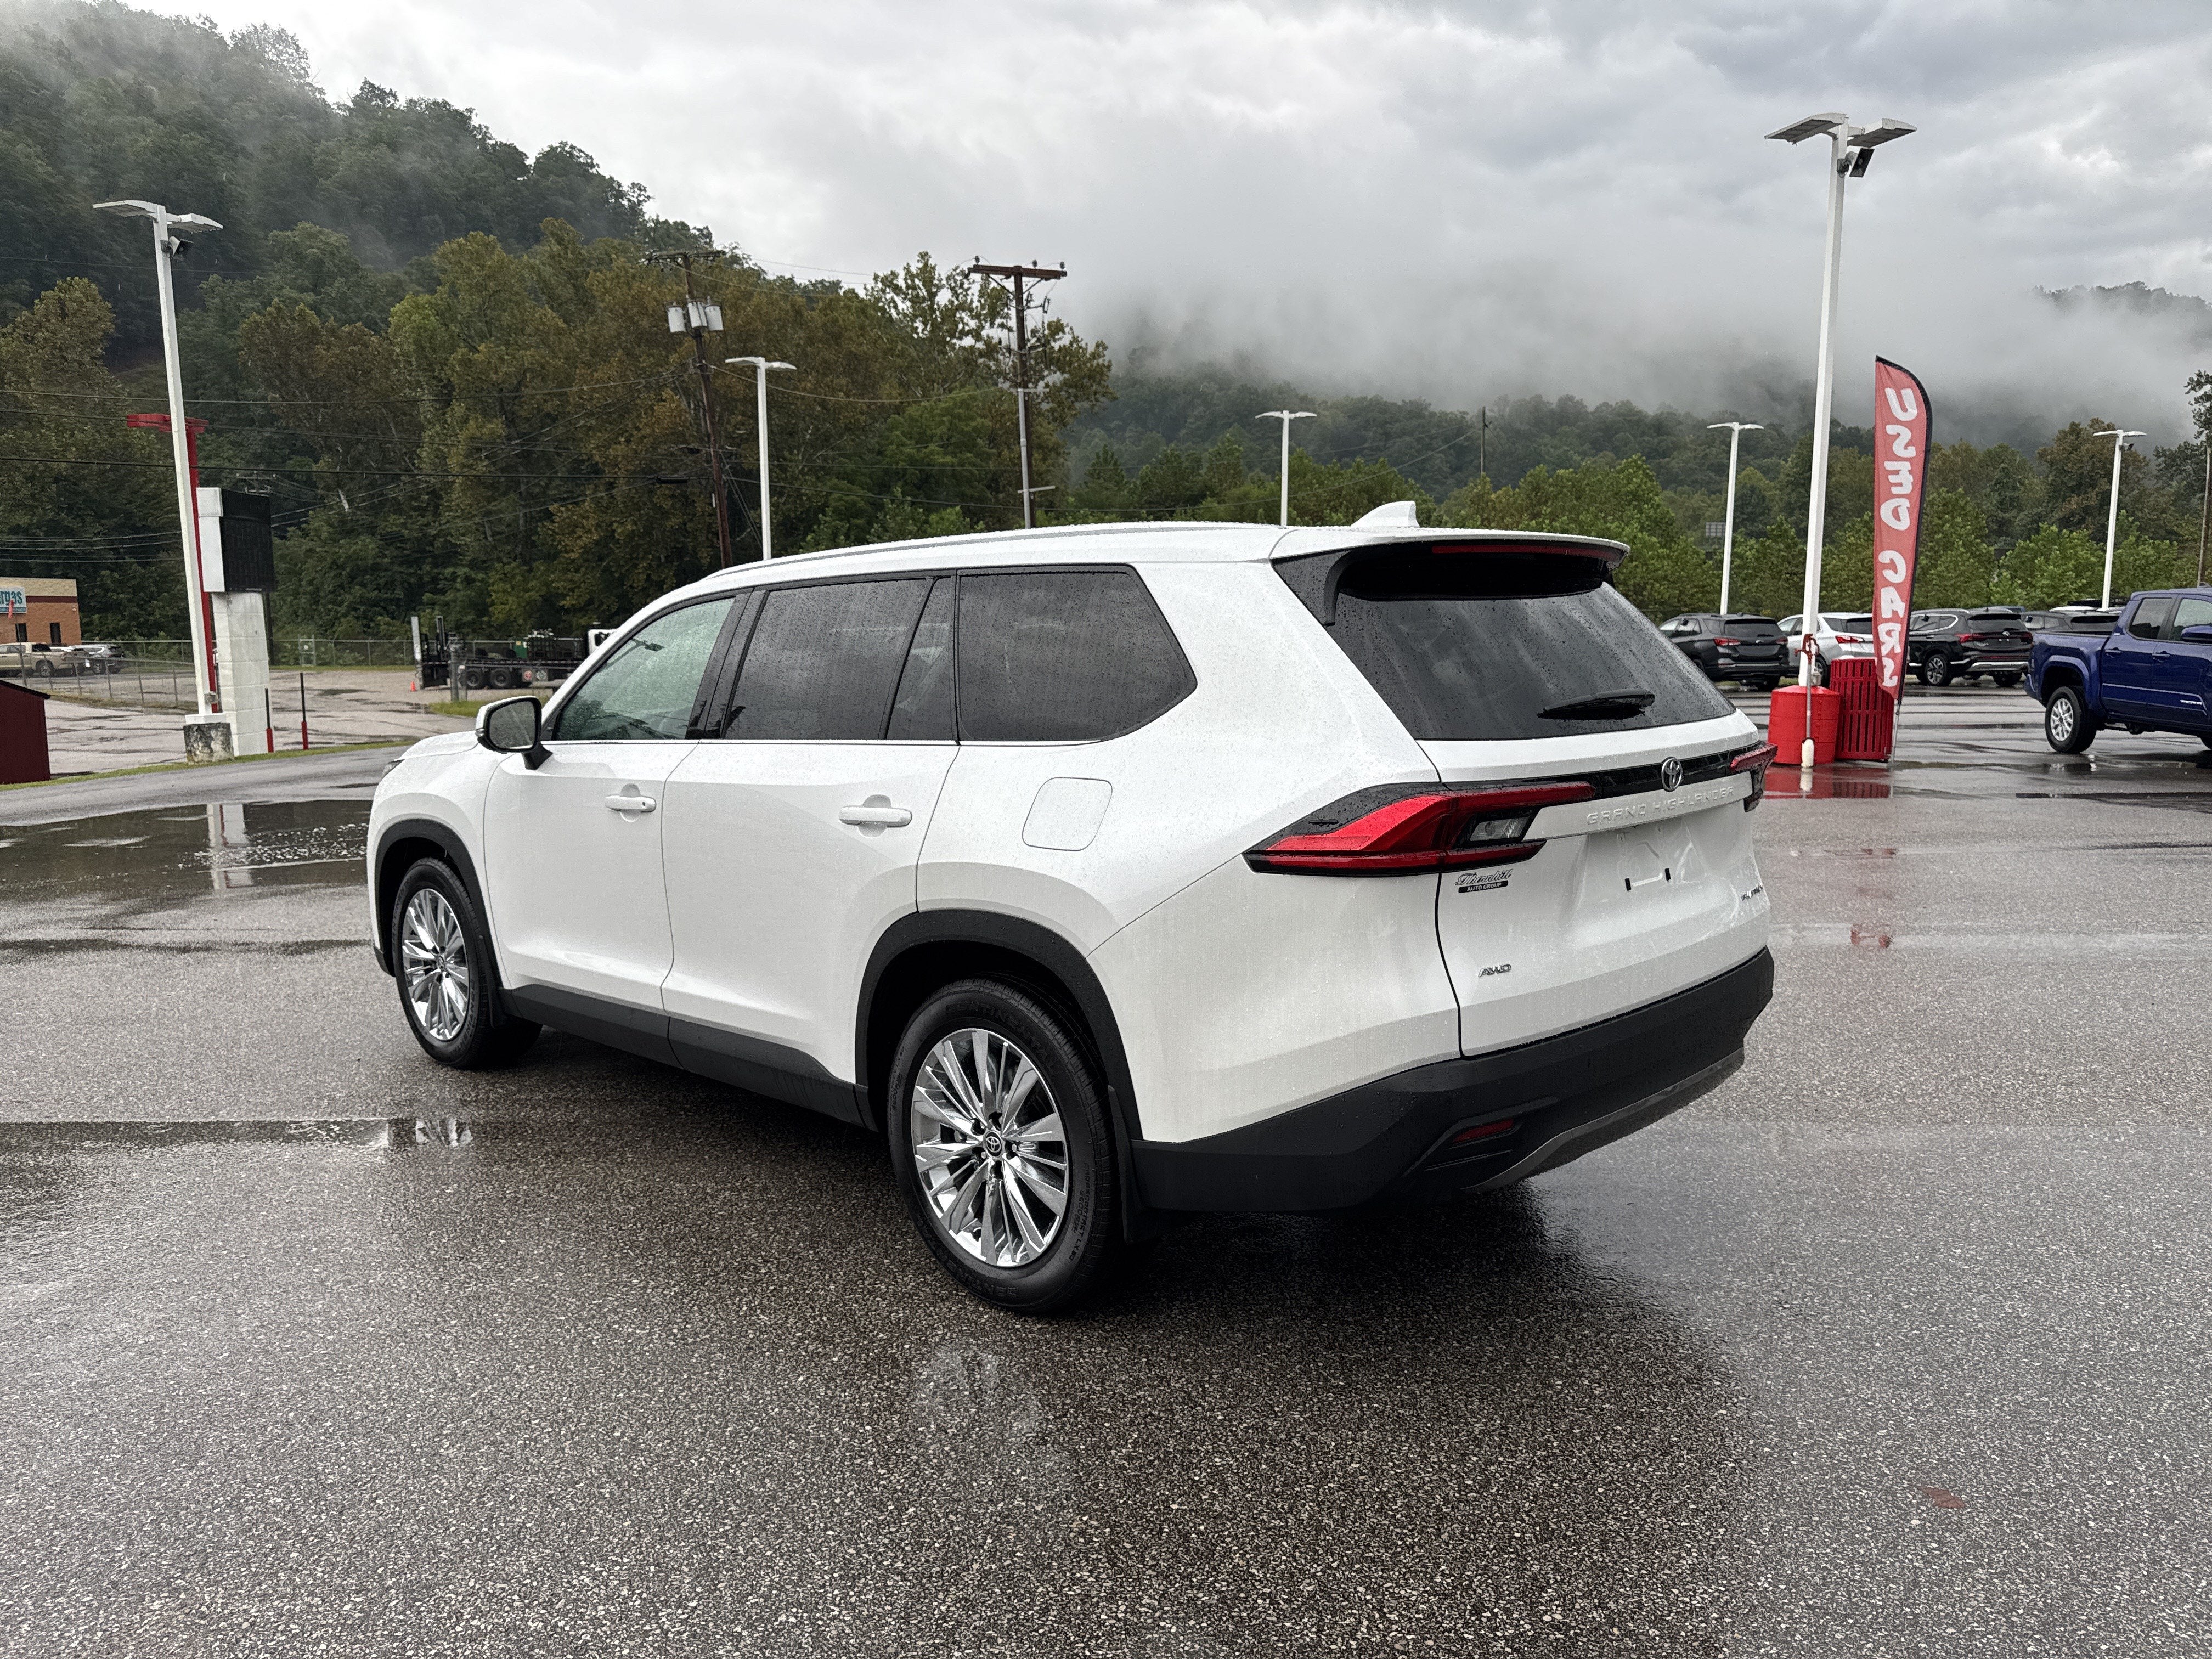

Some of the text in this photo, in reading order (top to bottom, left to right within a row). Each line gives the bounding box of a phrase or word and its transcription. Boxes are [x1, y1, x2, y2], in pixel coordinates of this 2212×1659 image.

[0, 591, 22, 606] rgas
[1587, 786, 1734, 825] GRAND HIGHLANDER
[1454, 868, 1513, 885] Thornhill
[1477, 964, 1511, 978] AWD
